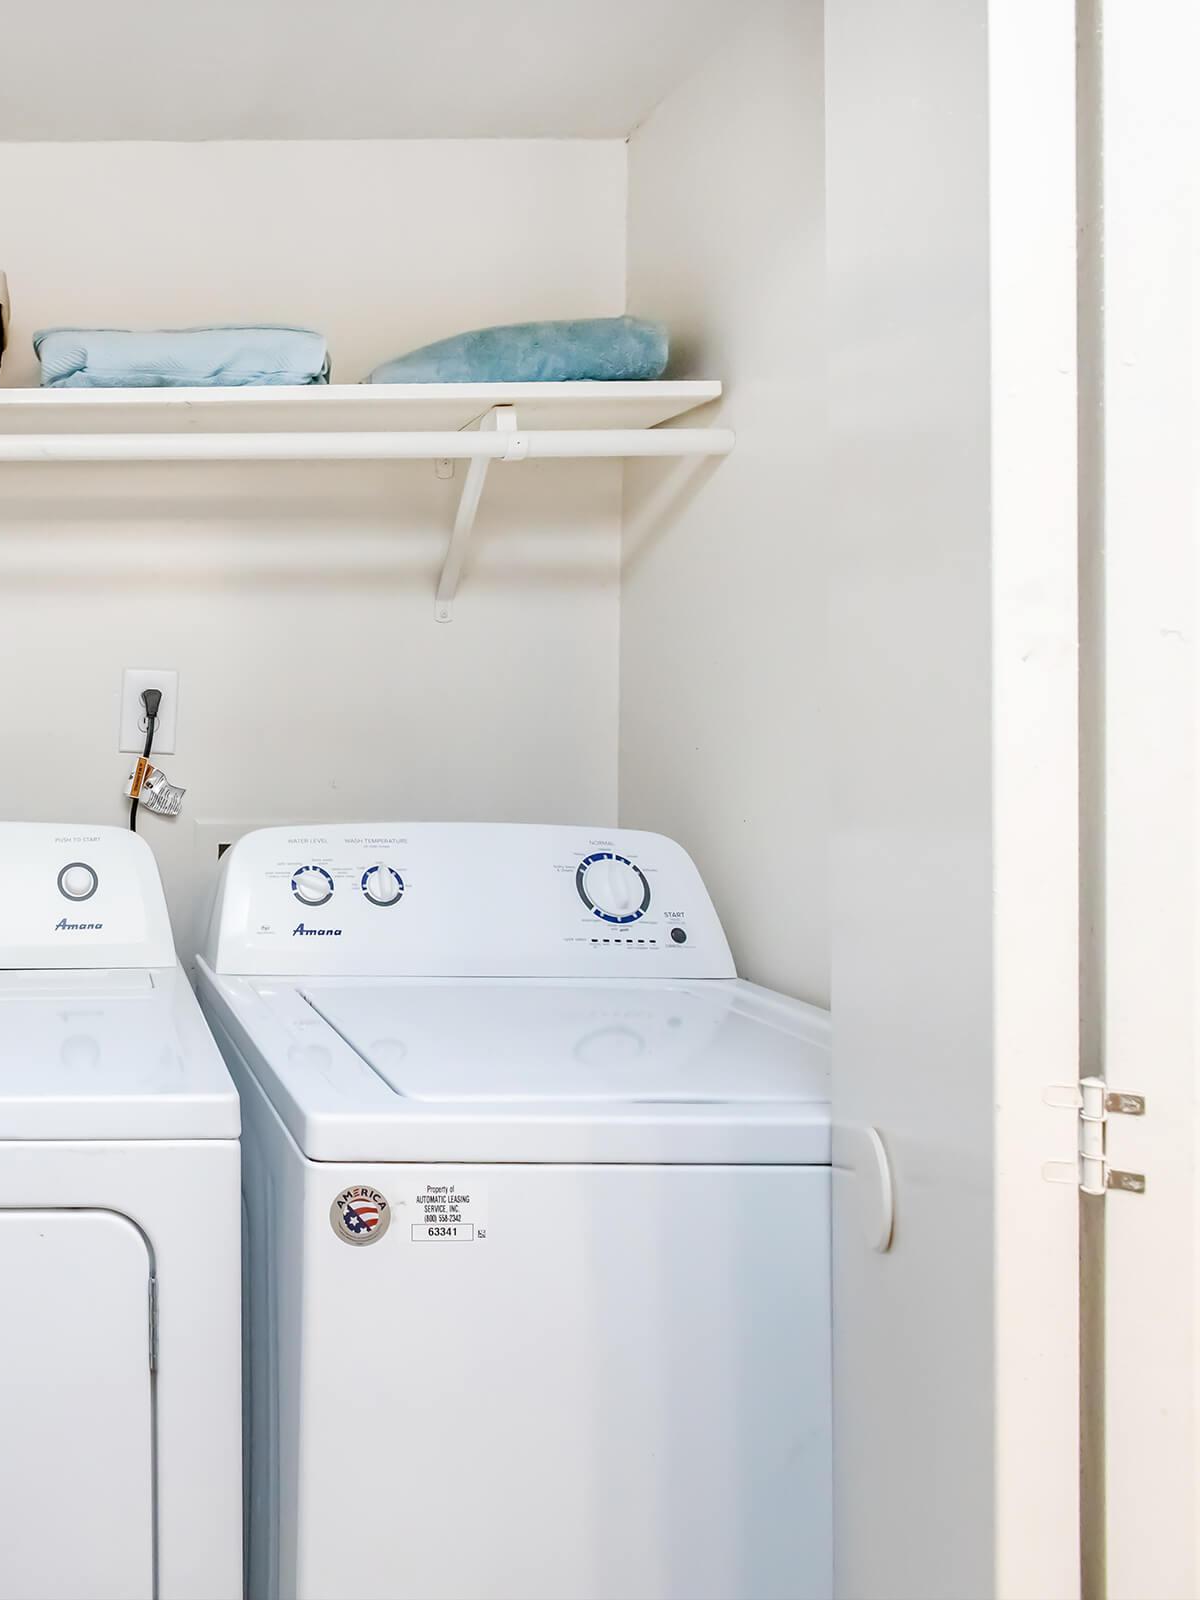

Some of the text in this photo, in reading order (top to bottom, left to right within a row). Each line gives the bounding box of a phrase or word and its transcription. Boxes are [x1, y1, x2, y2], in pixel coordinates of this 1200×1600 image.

[55, 918, 103, 931] Amana
[292, 923, 342, 937] Amana
[426, 1185, 448, 1194] Property
[336, 1188, 387, 1211] AMERICA
[416, 1195, 470, 1204] AUTOMATIC LEASING
[424, 1214, 462, 1223] (800) 558-2342
[428, 1227, 457, 1237] 63341
